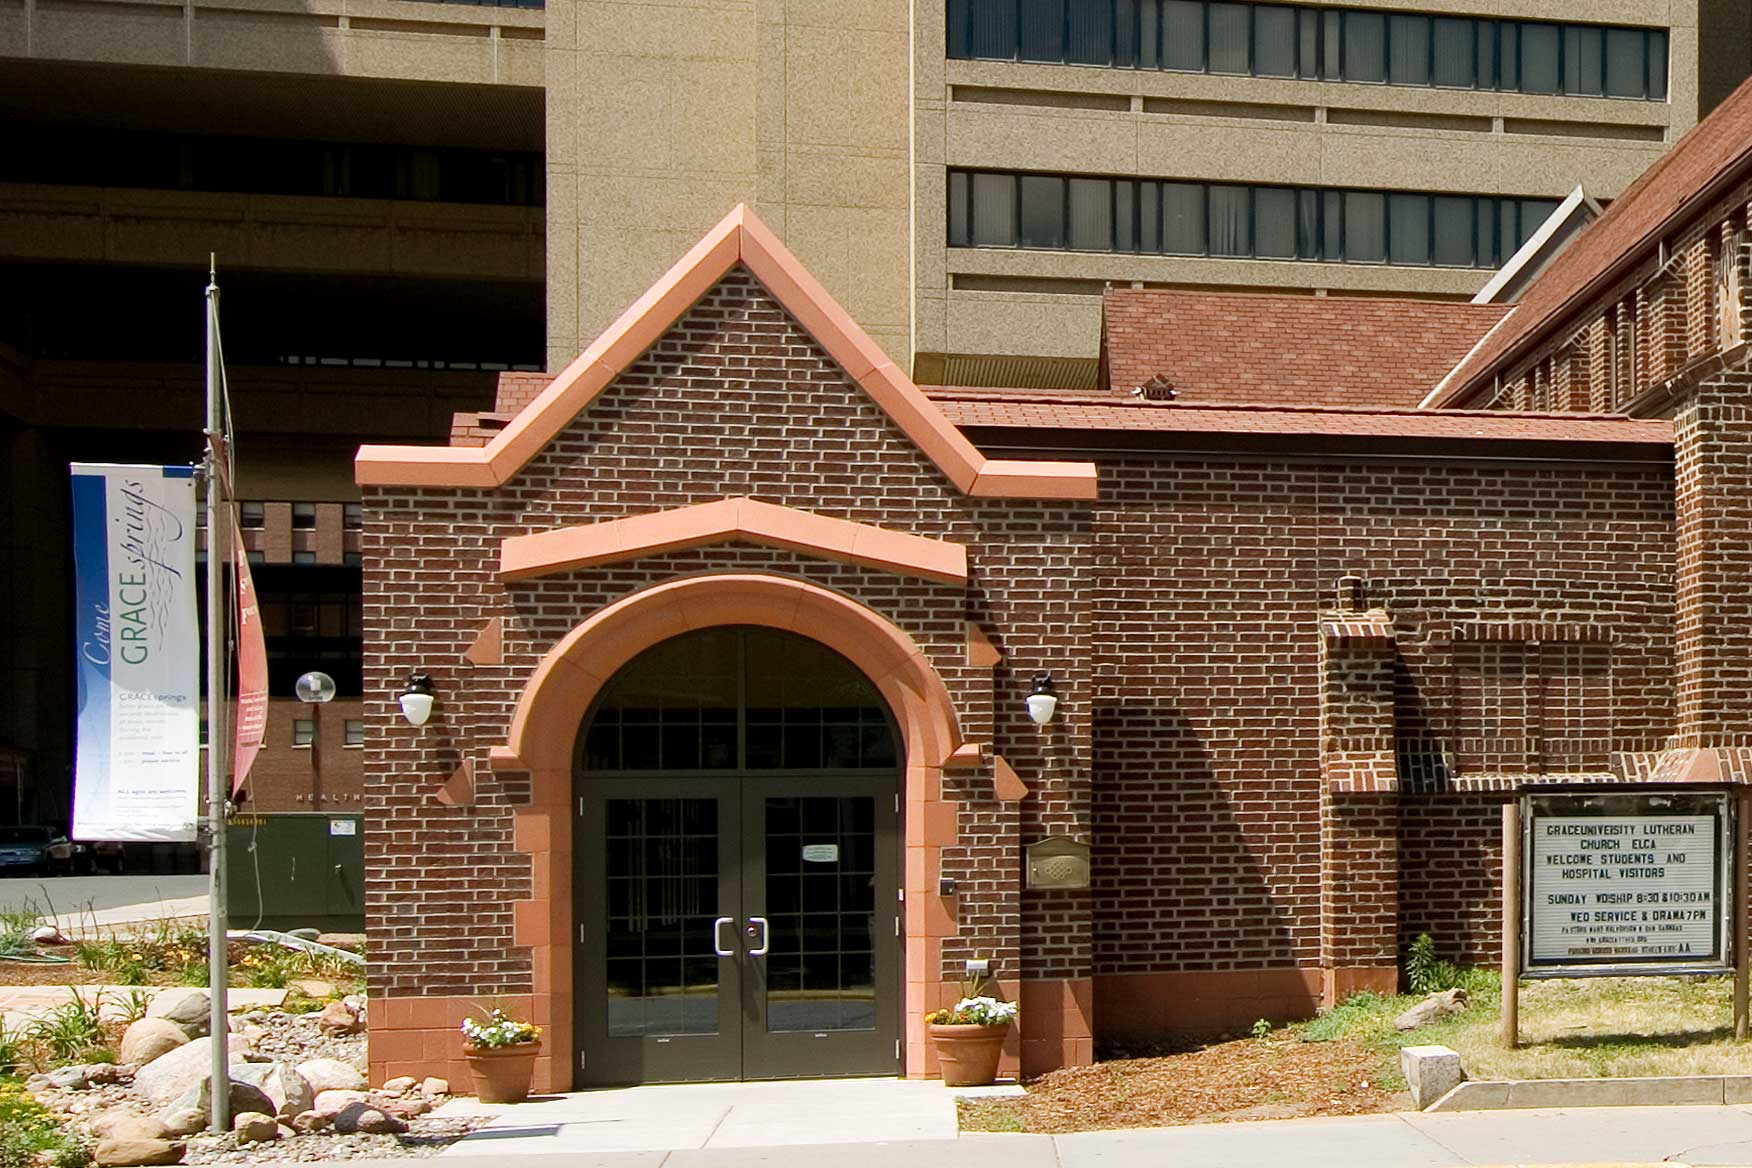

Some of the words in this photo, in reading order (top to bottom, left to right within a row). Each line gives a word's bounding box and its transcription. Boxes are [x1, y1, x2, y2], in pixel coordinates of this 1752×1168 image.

[83, 603, 112, 665] Come
[1643, 824, 1695, 835] LUTHERAN
[1580, 839, 1620, 850] CHURCH
[1632, 839, 1656, 849] ELCA
[1546, 855, 1593, 865] WELCOME
[1600, 854, 1655, 865] STUDENTS
[1666, 853, 1686, 864] AND
[1562, 868, 1612, 879] HOSPITAL
[1619, 867, 1665, 878] VISITORS
[1547, 894, 1587, 905] SUNDAY
[1594, 911, 1637, 922] SERVICE
